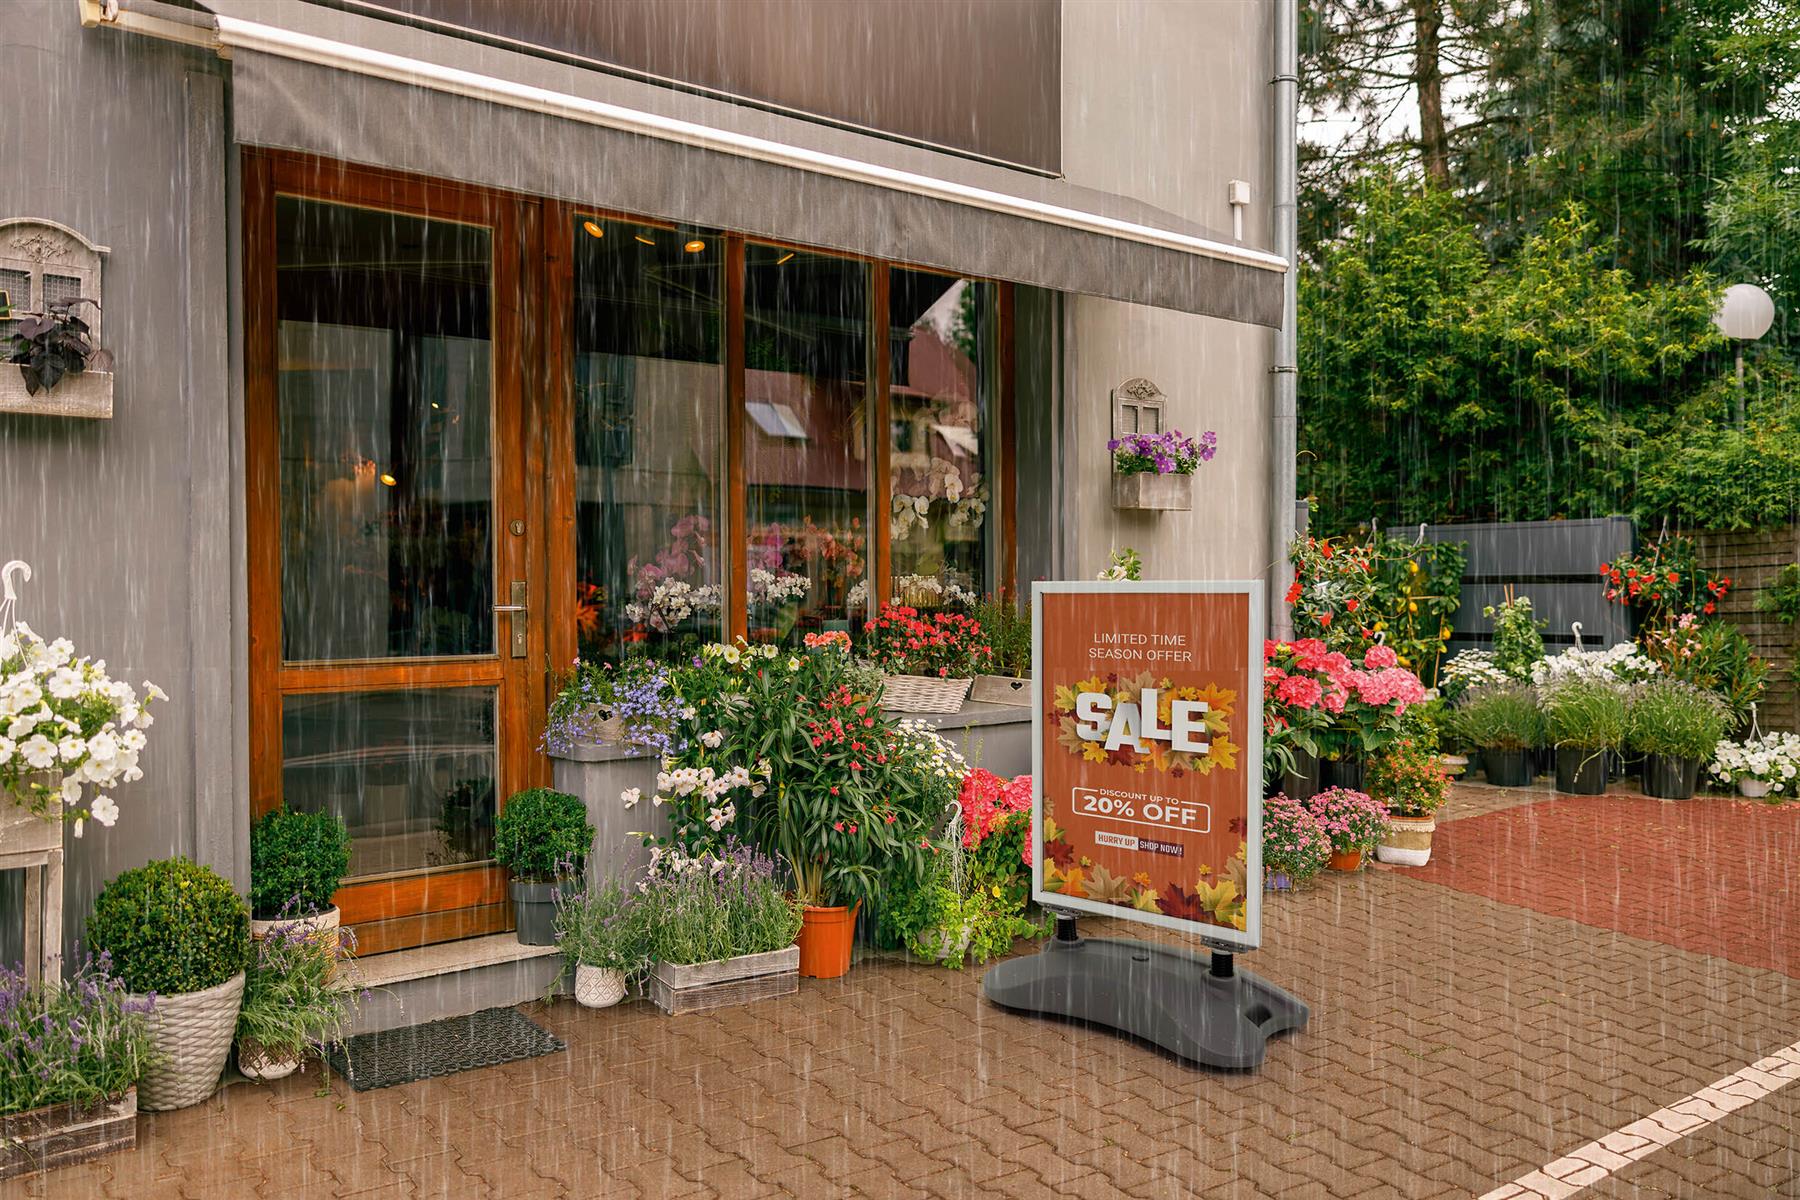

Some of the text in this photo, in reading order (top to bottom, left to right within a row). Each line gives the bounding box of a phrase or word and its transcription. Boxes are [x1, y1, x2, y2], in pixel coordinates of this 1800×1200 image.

[1094, 633, 1186, 646] LIMITED TIME
[1089, 648, 1192, 662] SEASON OFFER
[1076, 688, 1209, 754] SALE
[1099, 788, 1179, 806] DISCOUNT UP TO
[1083, 795, 1197, 825] 20% OFF
[1098, 834, 1124, 846] HURRY
[1124, 836, 1136, 847] UP
[1139, 840, 1159, 851] SHOP
